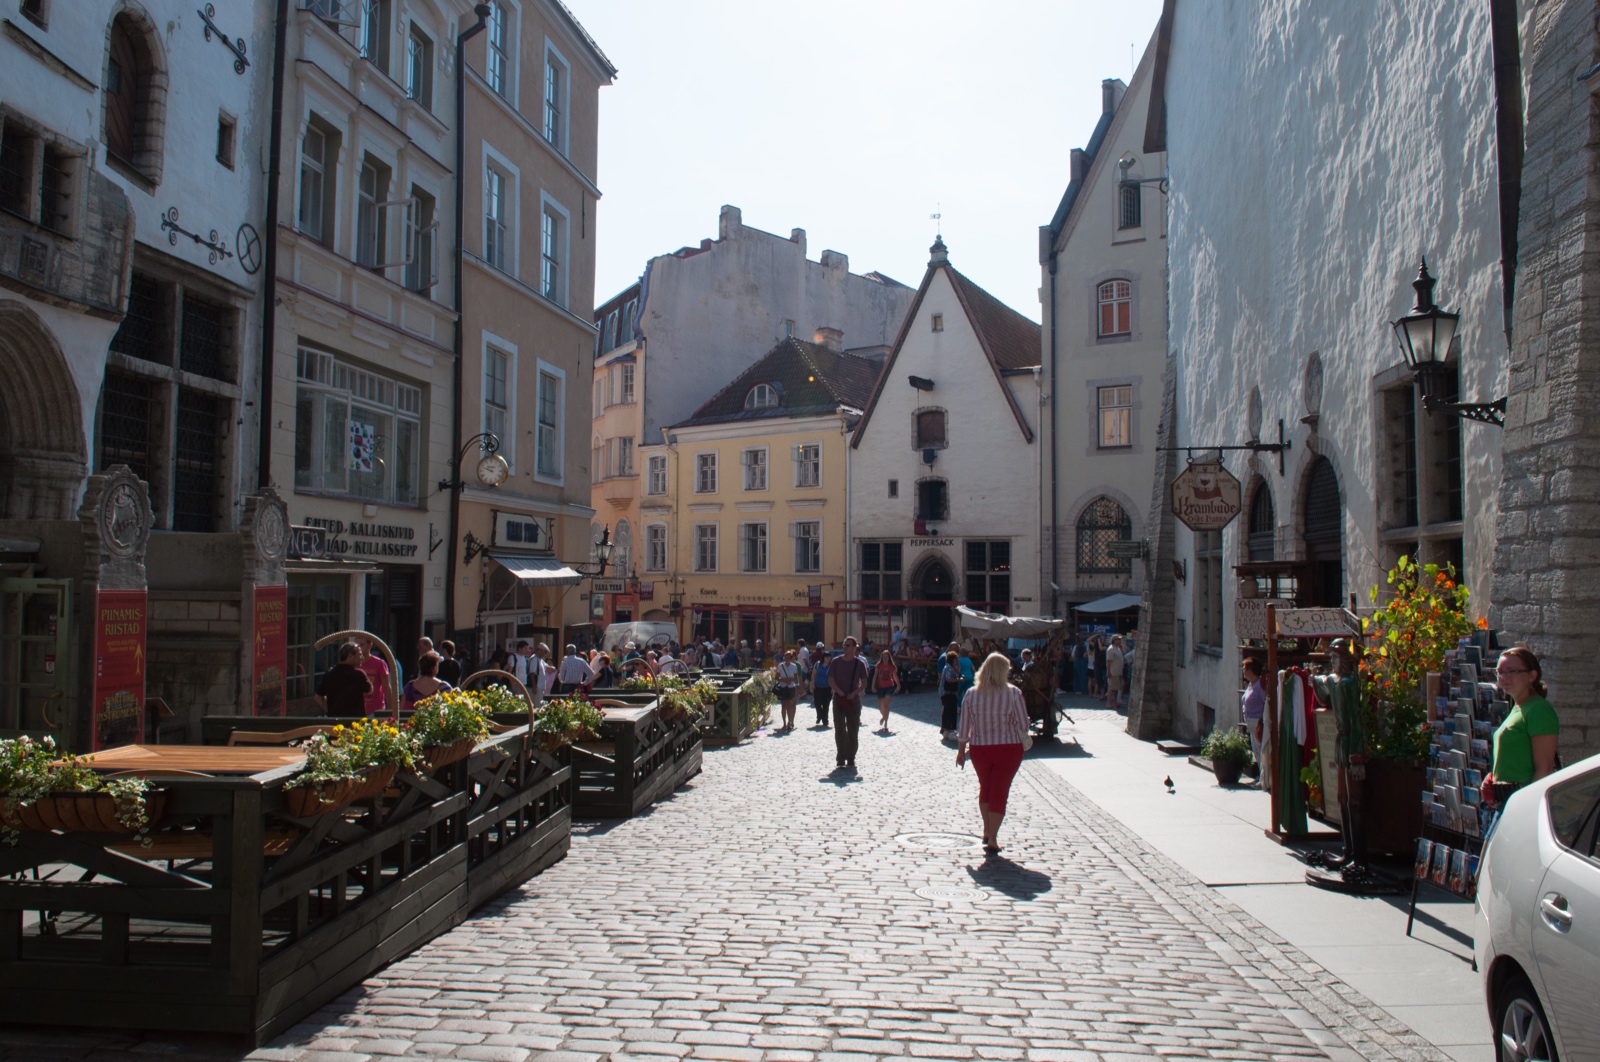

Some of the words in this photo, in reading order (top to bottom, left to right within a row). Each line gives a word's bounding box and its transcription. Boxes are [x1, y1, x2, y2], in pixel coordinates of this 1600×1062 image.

[1177, 495, 1236, 516] Krambude
[350, 522, 415, 540] KALLISKIVID
[355, 541, 418, 557] KULLASSEPP
[910, 539, 955, 547] PEPPERSACK
[101, 608, 144, 621] PIINAMIS-
[105, 623, 140, 636] RIISTAD
